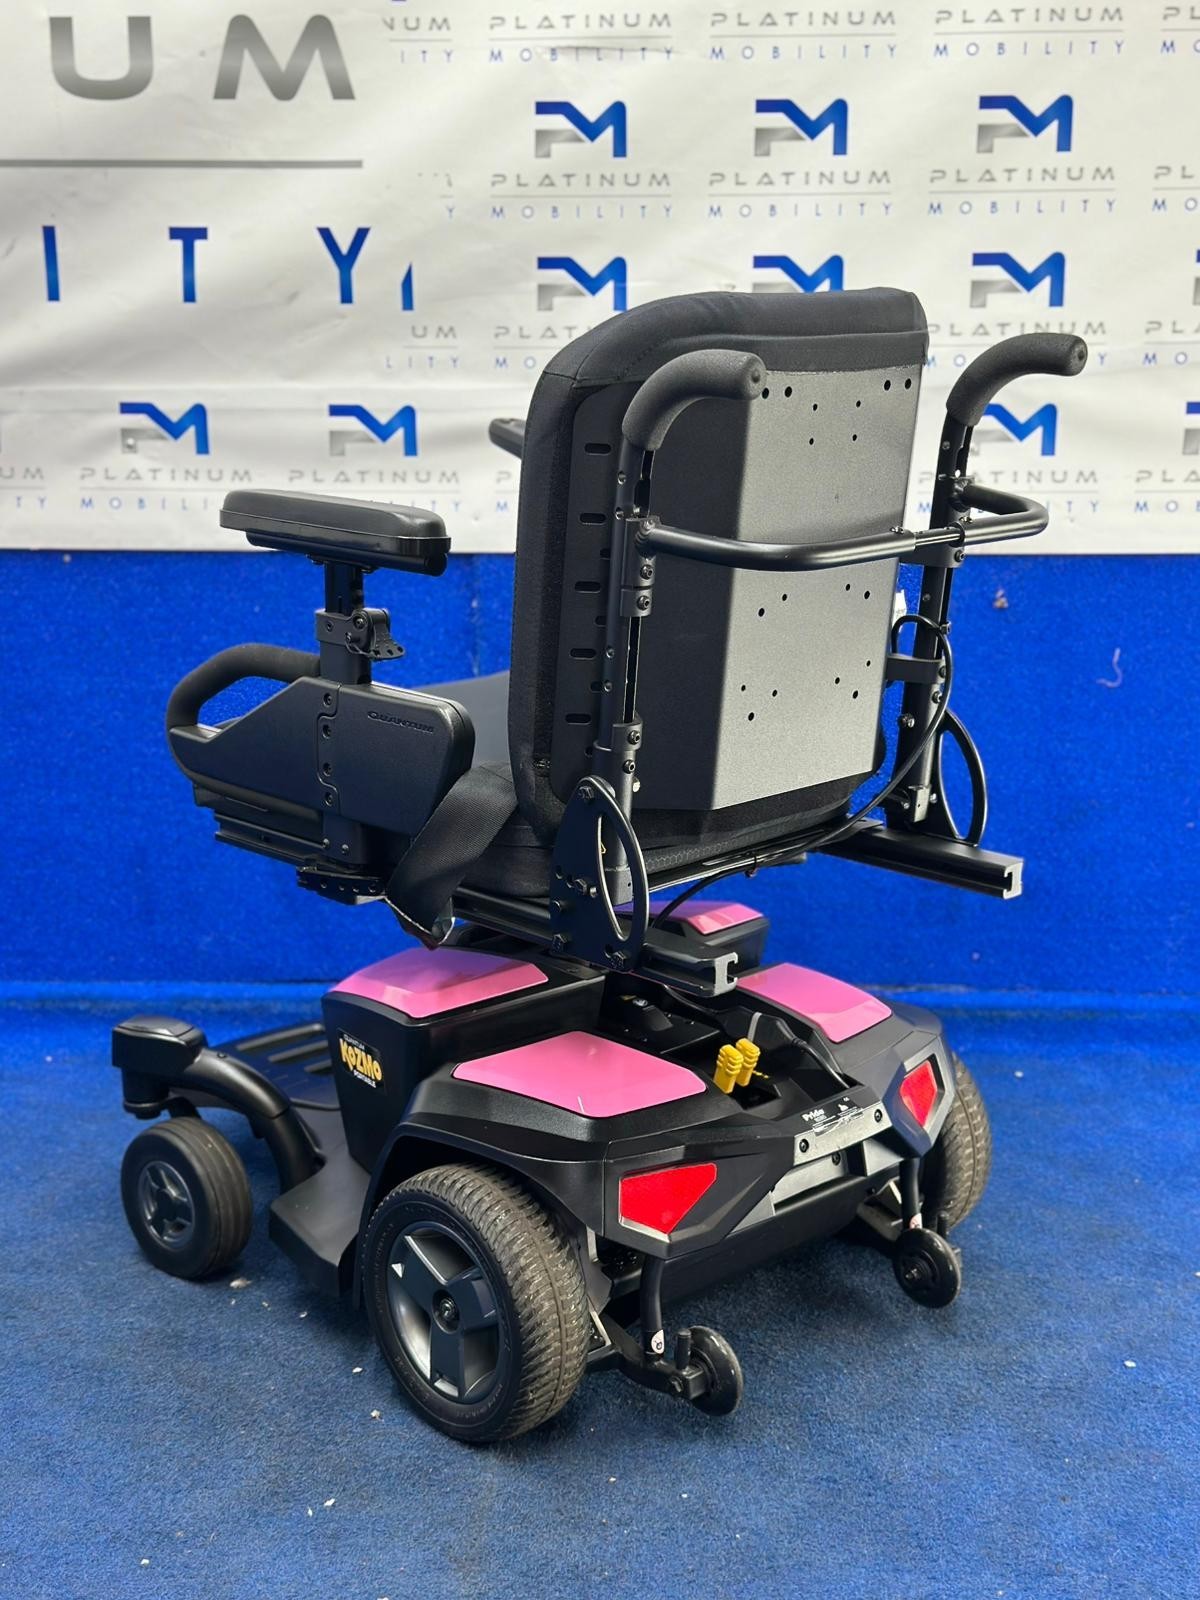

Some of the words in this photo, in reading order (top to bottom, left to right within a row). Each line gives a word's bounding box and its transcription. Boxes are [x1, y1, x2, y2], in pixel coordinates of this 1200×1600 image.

[489, 13, 672, 30] PLATINUM
[711, 10, 896, 27] PLATINUM
[935, 7, 1123, 24] PLATINUM
[490, 46, 673, 62] MOBILITY
[710, 44, 897, 60] MOBILITY
[934, 40, 1124, 57] MOBILITY
[491, 172, 671, 187] PLATINUM
[708, 170, 891, 186] PLATINUM
[929, 167, 1115, 183] PLATINUM
[490, 205, 672, 219] MOBILITY
[708, 202, 892, 218] MOBILITY
[928, 198, 1116, 215] MOBILITY
[493, 325, 578, 340] PLAT
[79, 468, 253, 482] PLATINUM
[287, 469, 460, 484] PLATINUM
[917, 470, 1099, 484] PTINUM
[80, 496, 210, 511] MOBILI
